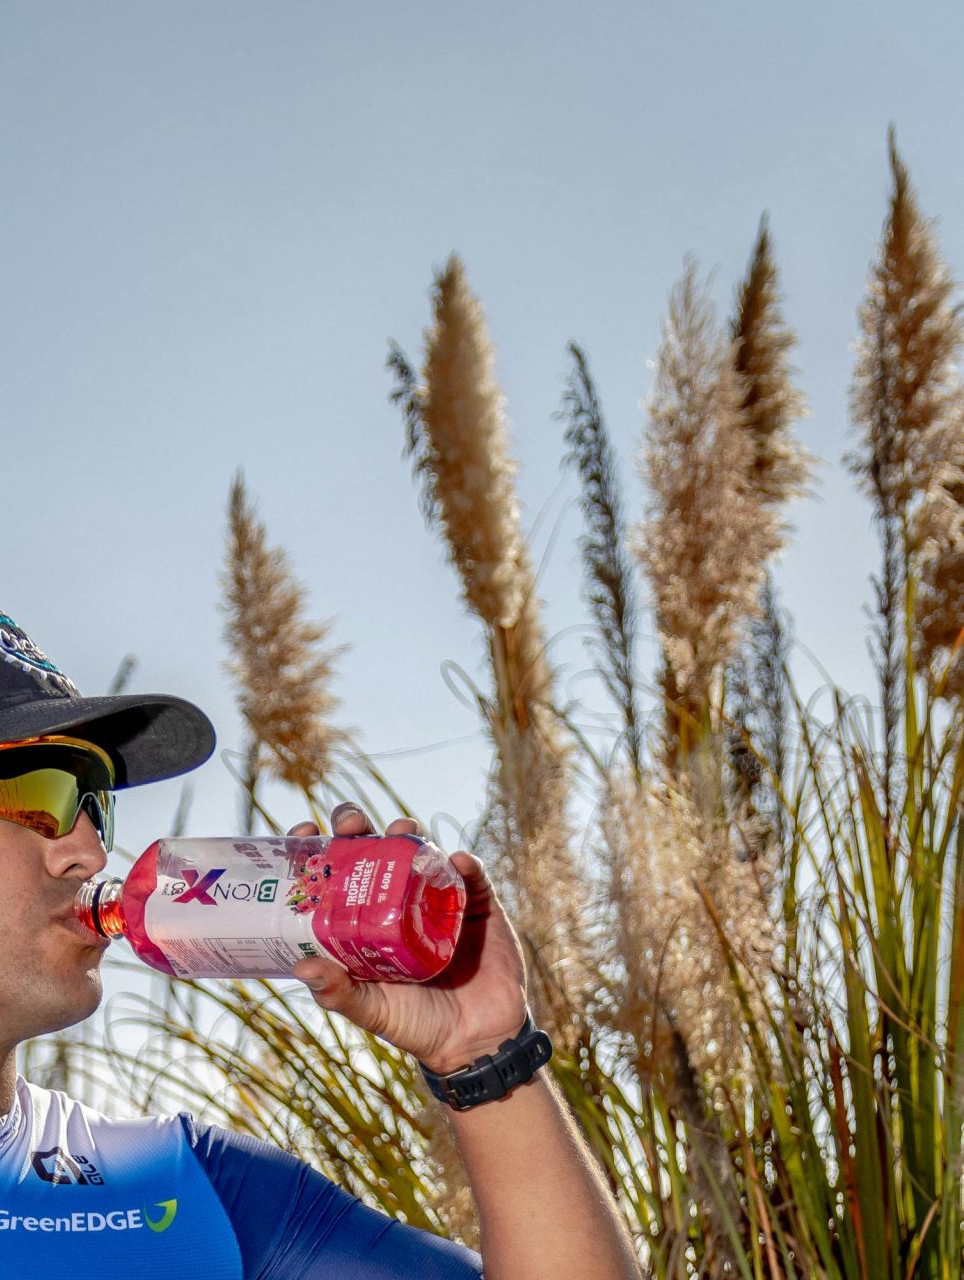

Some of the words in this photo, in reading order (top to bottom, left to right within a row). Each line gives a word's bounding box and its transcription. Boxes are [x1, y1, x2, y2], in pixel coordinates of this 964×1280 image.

[346, 858, 367, 907] TROPICAL
[357, 861, 375, 905] BERRIES
[381, 872, 393, 890] 600
